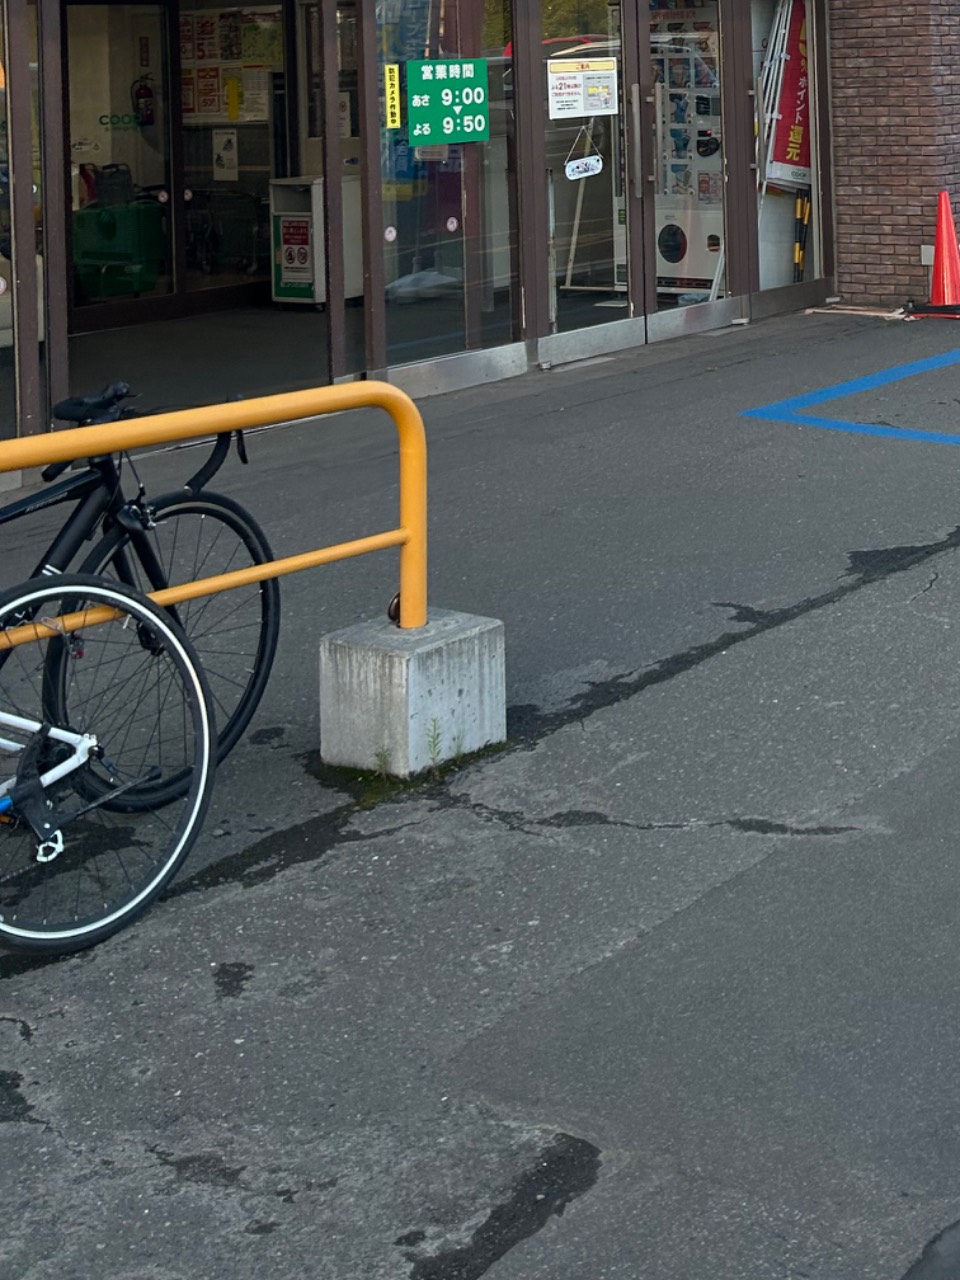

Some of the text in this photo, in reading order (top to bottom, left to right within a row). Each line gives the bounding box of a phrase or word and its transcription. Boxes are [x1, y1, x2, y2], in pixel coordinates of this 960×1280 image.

[421, 63, 475, 80] 営業時間
[412, 87, 485, 108] あさ 9:00
[413, 115, 486, 136] よる 9:50
